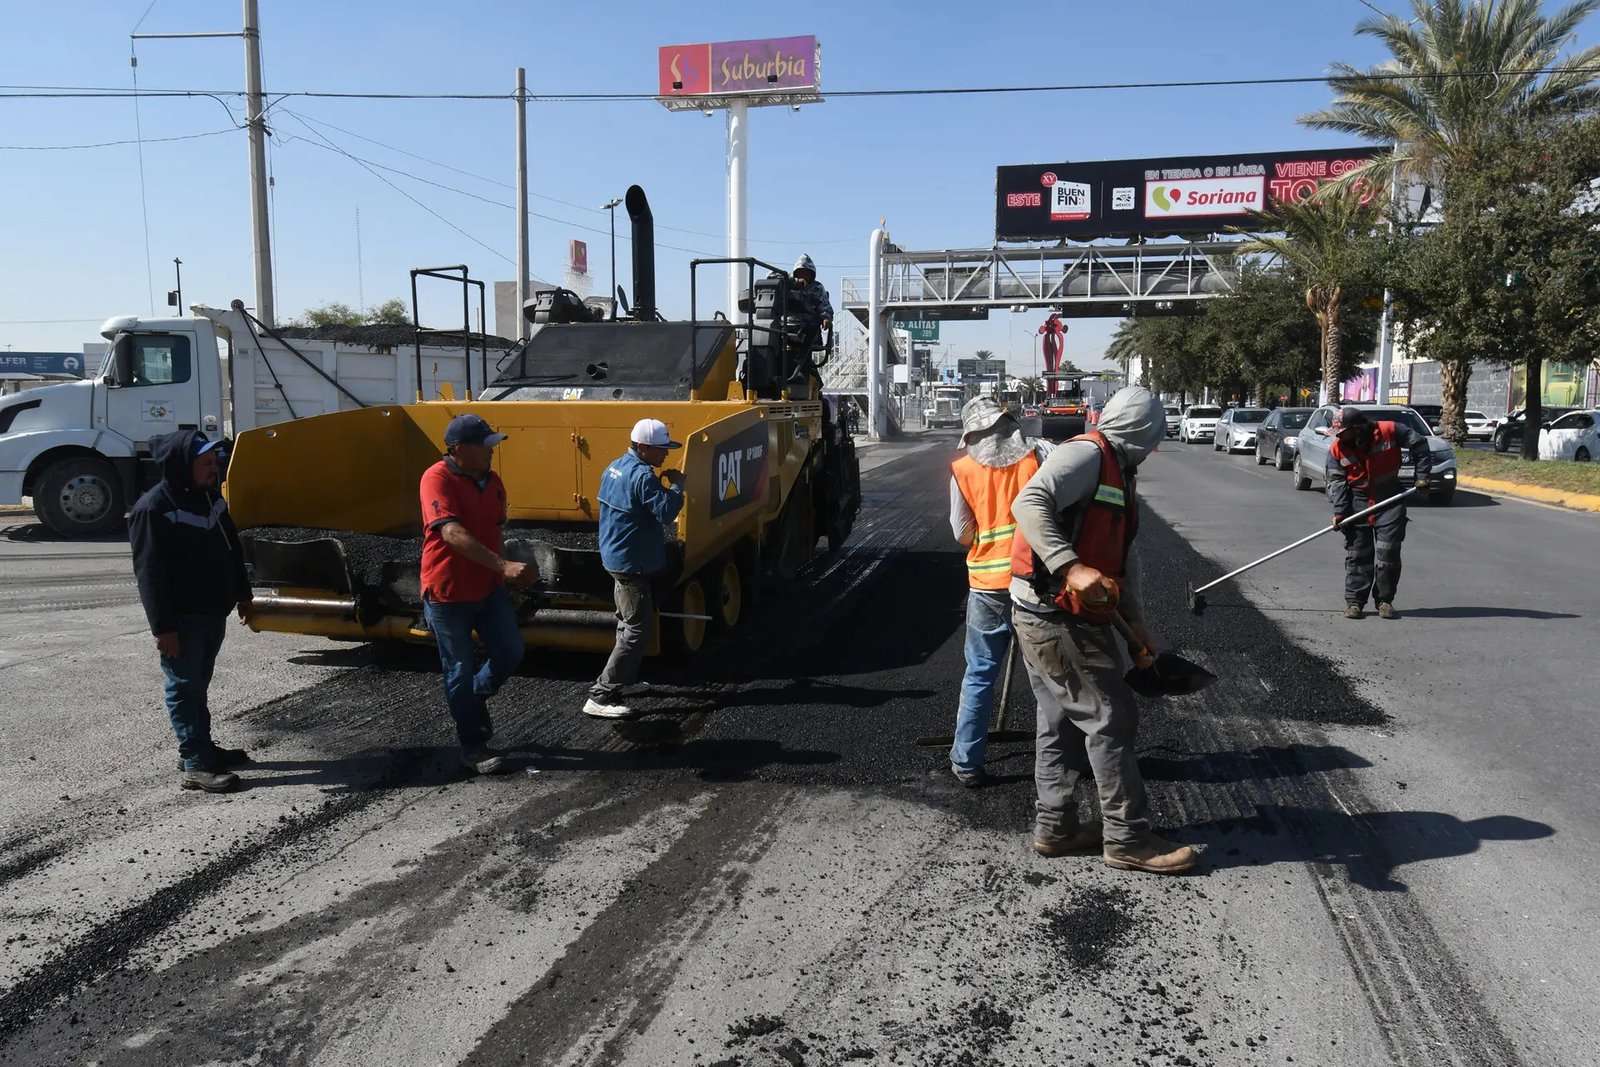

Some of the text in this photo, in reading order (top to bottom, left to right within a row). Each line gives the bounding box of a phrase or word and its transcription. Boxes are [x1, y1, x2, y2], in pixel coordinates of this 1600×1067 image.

[721, 50, 806, 86] Suburbia
[1145, 163, 1265, 180] EN TIENDA O EN LÍNEA
[1275, 161, 1327, 177] VIENE
[1043, 175, 1055, 183] XV
[1007, 193, 1041, 207] ESTE
[1058, 187, 1085, 197] BUEN
[1187, 188, 1257, 205] Soriana
[562, 388, 584, 400] CAT
[718, 450, 743, 501] CAT
